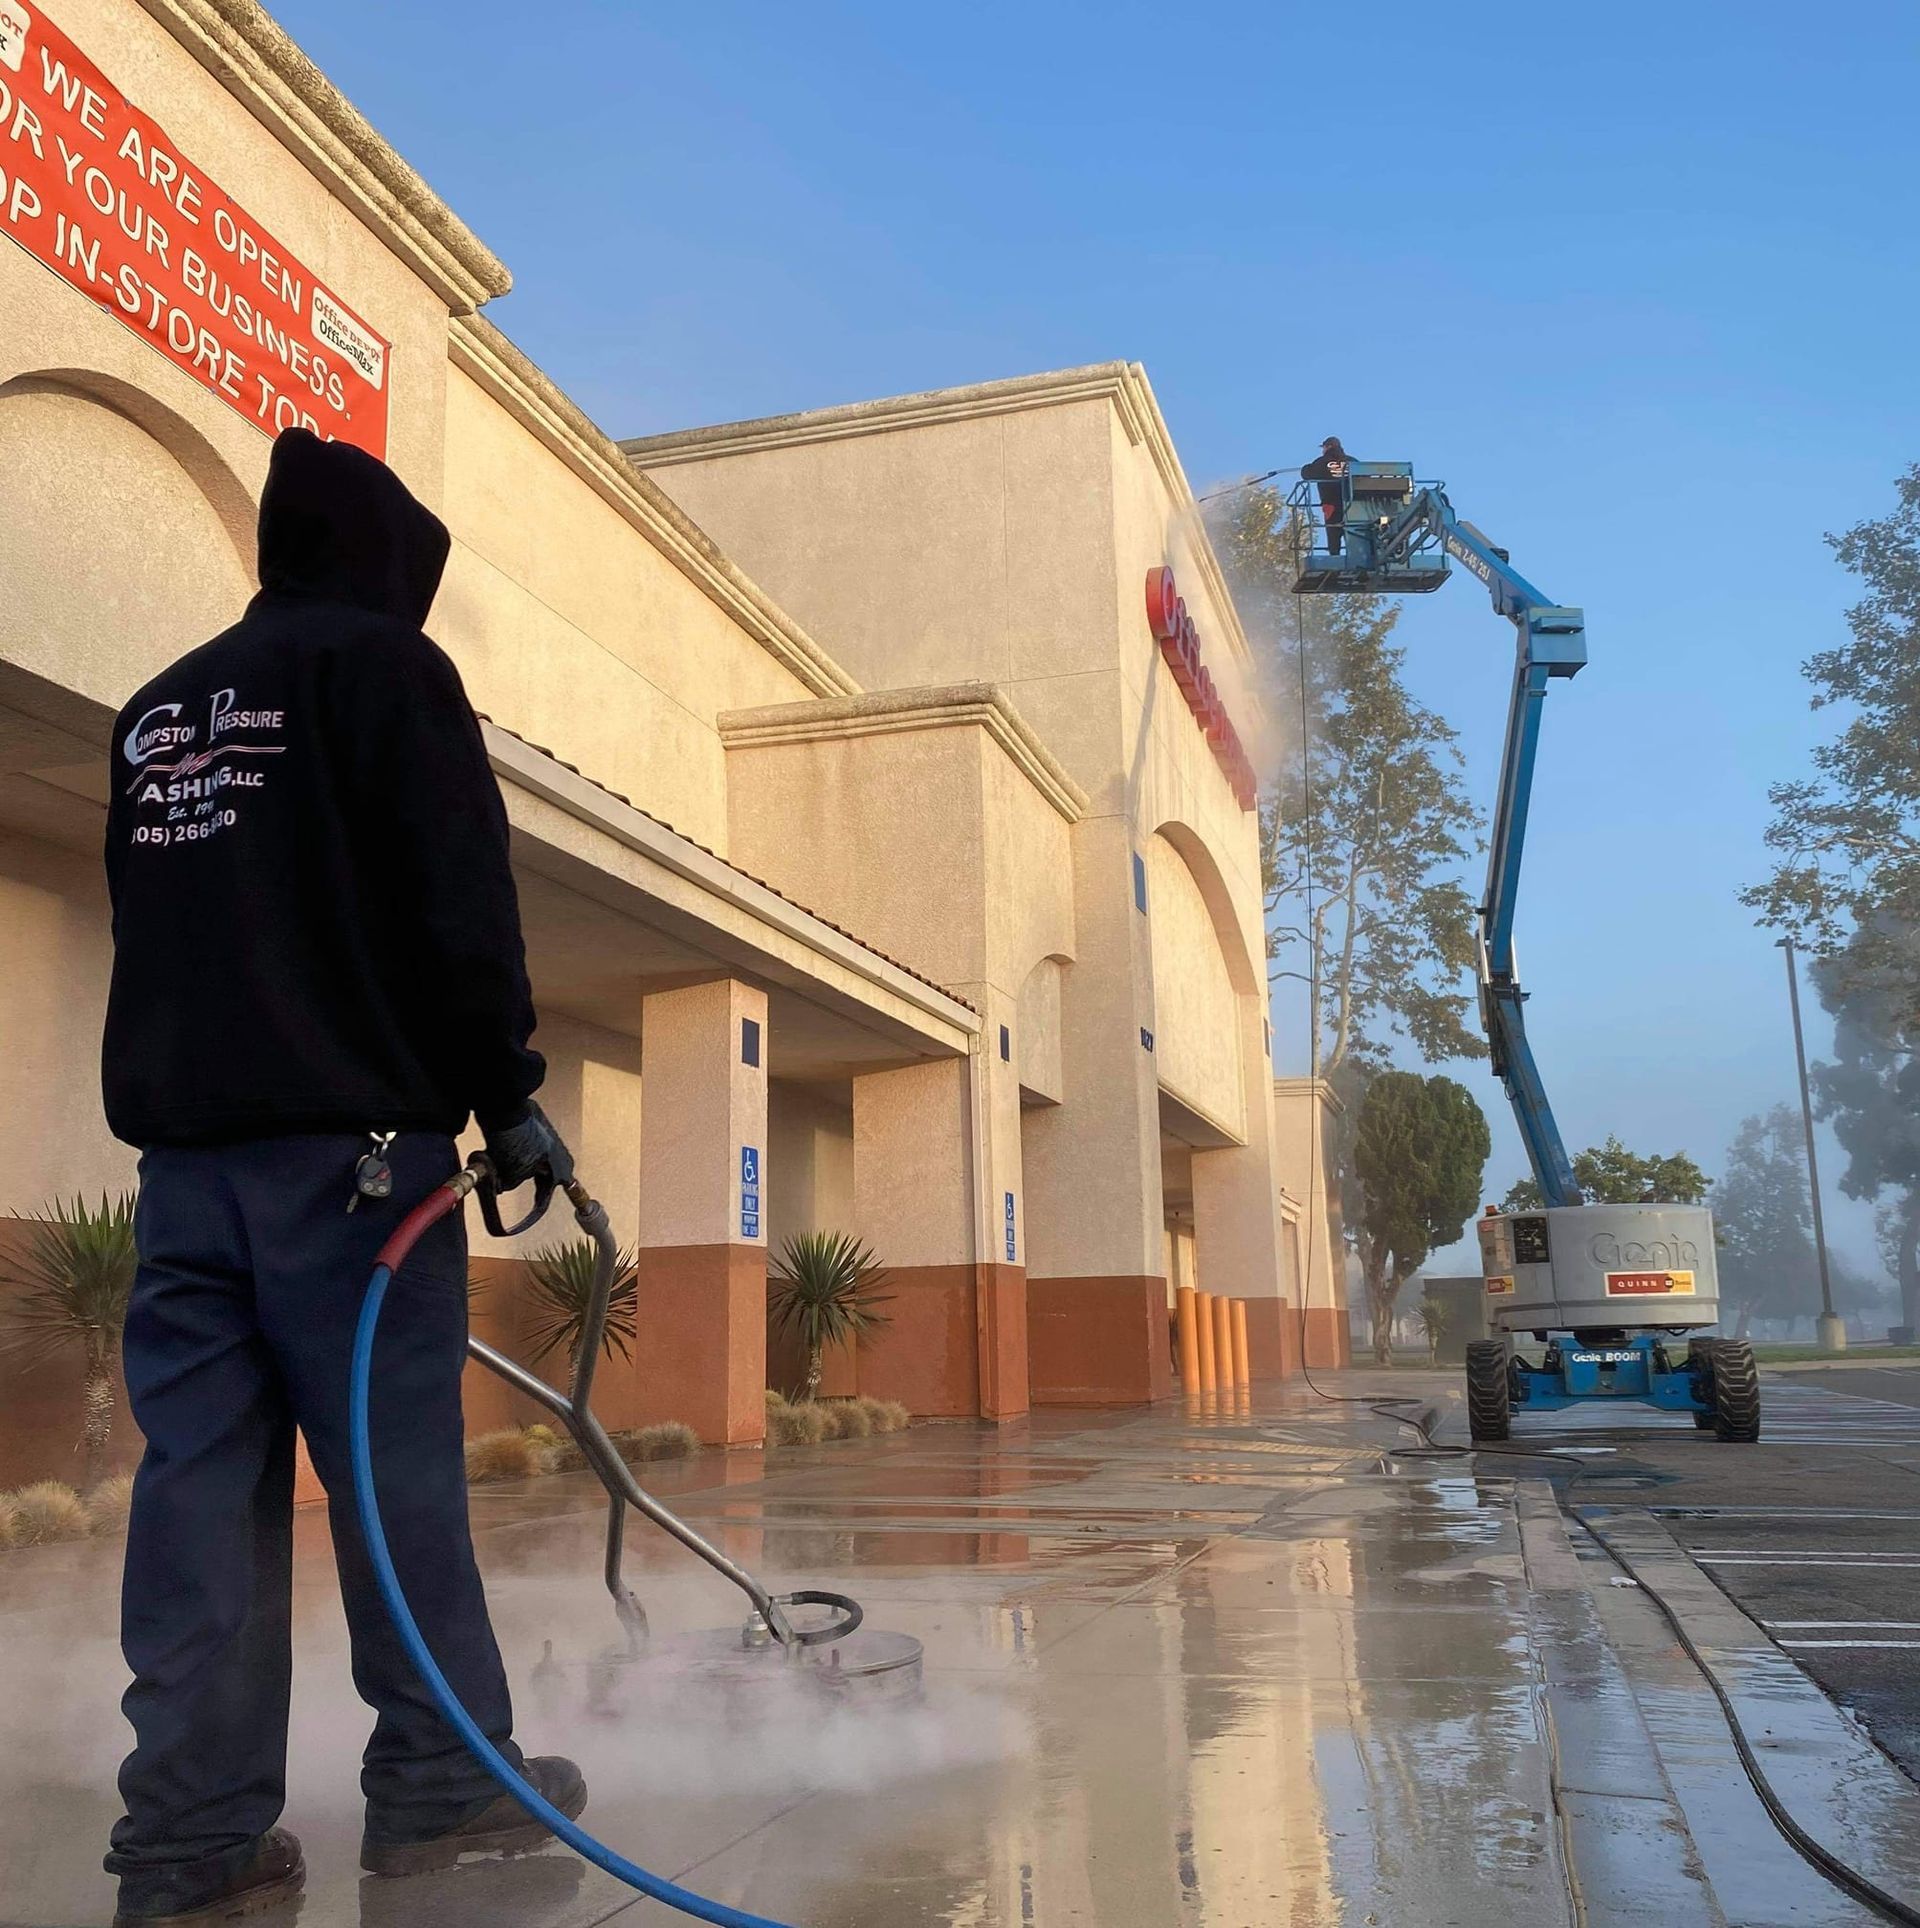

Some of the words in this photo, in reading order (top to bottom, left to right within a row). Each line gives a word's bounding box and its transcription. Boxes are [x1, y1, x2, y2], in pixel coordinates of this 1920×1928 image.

[39, 45, 107, 142] WE
[118, 126, 202, 225] ARE
[213, 208, 301, 315] OPEN
[56, 135, 171, 270] YOUR
[182, 247, 352, 420] BUSINESS.
[53, 213, 246, 400] IN-STORE
[315, 297, 348, 336] Office
[320, 319, 374, 376] OfficeMax
[208, 688, 284, 744] PRESSURE
[1586, 1232, 1699, 1269] Genie
[1618, 1280, 1657, 1288] QUINN
[1572, 1352, 1602, 1362] Genie
[1605, 1352, 1641, 1362] BOOM
